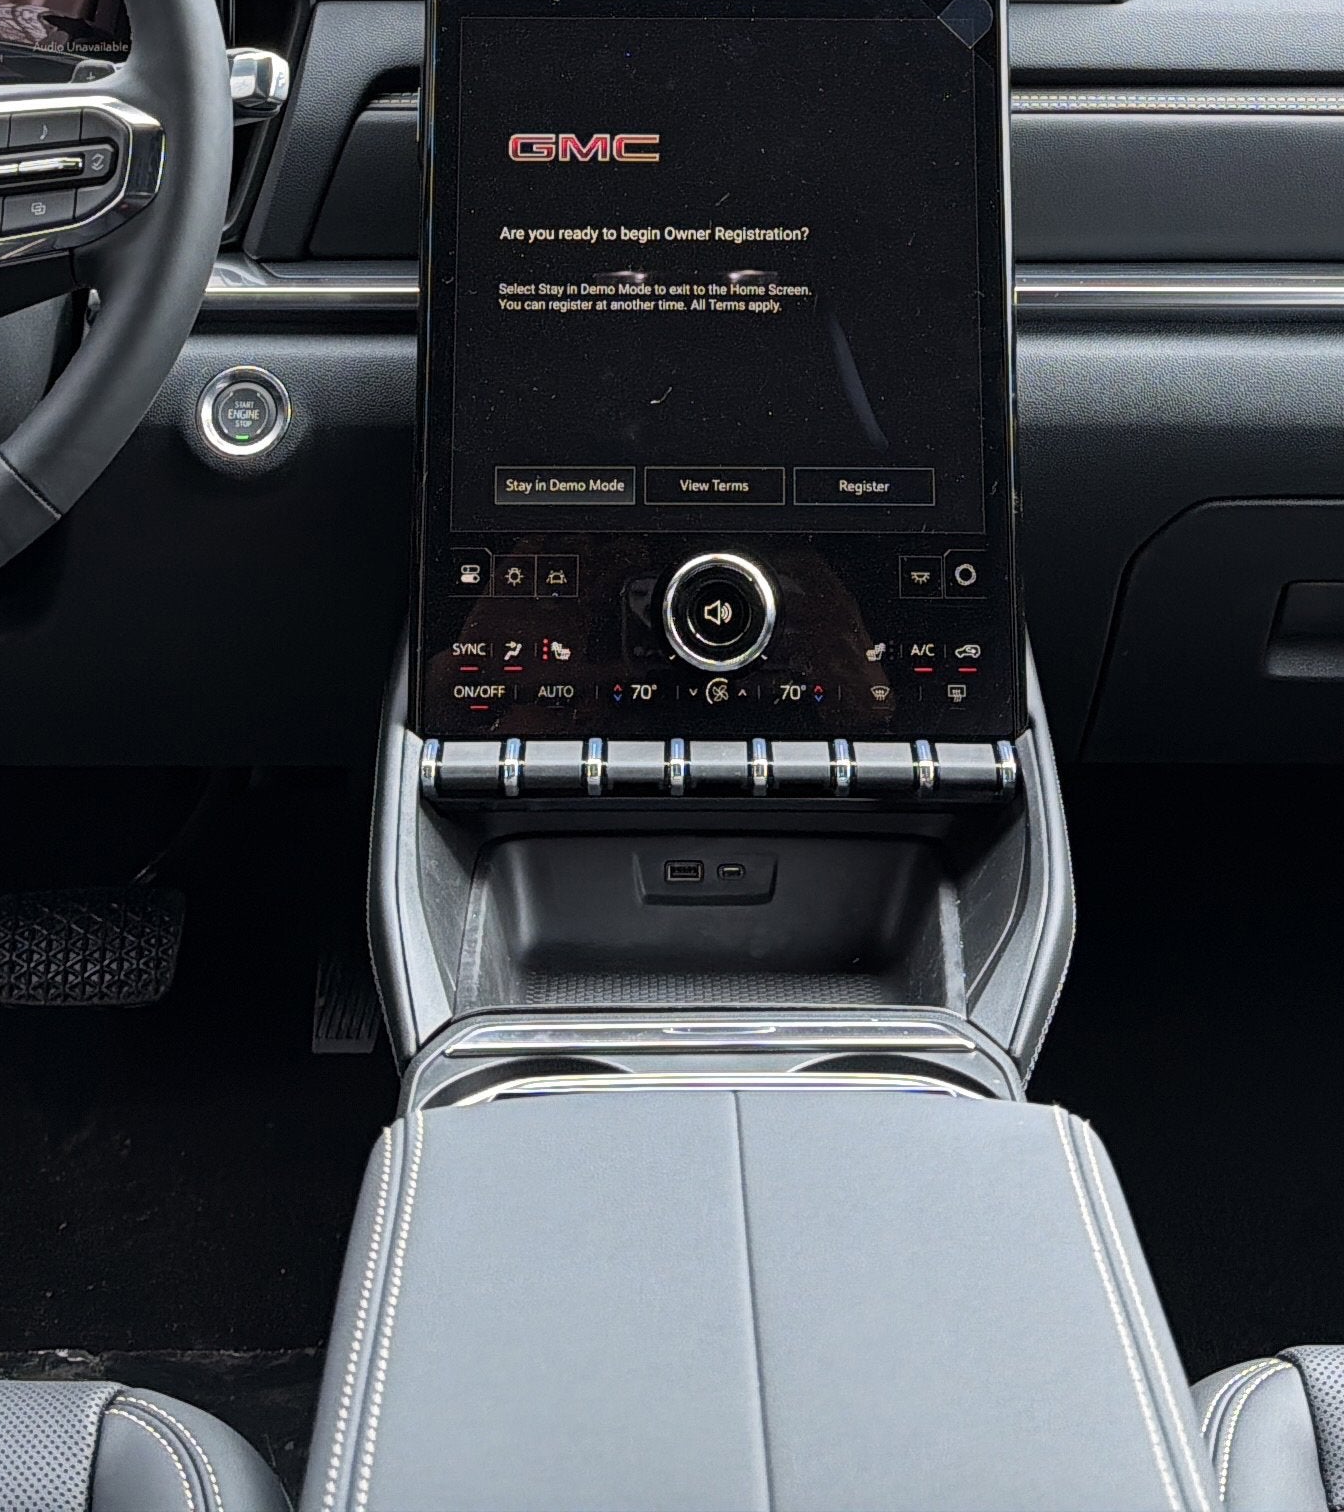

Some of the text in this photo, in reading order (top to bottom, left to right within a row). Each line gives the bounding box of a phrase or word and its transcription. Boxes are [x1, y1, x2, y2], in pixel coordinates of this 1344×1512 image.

[33, 41, 129, 53] Audio Unavailable
[508, 133, 660, 162] GMC
[499, 226, 810, 243] Are you ready to begin Owner Registration?
[499, 283, 812, 297] Select Stay in Demo Mode to exit to the Home Screen.
[498, 299, 782, 313] You can register at another time. All Terms apply.
[227, 409, 260, 420] ENGINE
[235, 420, 252, 428] STOP
[506, 478, 625, 494] Stay in Demo Mode
[680, 479, 749, 493] View Terms
[839, 479, 890, 495] Register
[453, 643, 486, 656] SYNC
[911, 644, 935, 658] A/C
[454, 686, 505, 697] ON/OFF
[538, 686, 574, 697] AUTO
[631, 685, 657, 700] 70°
[780, 685, 806, 700] 70°
